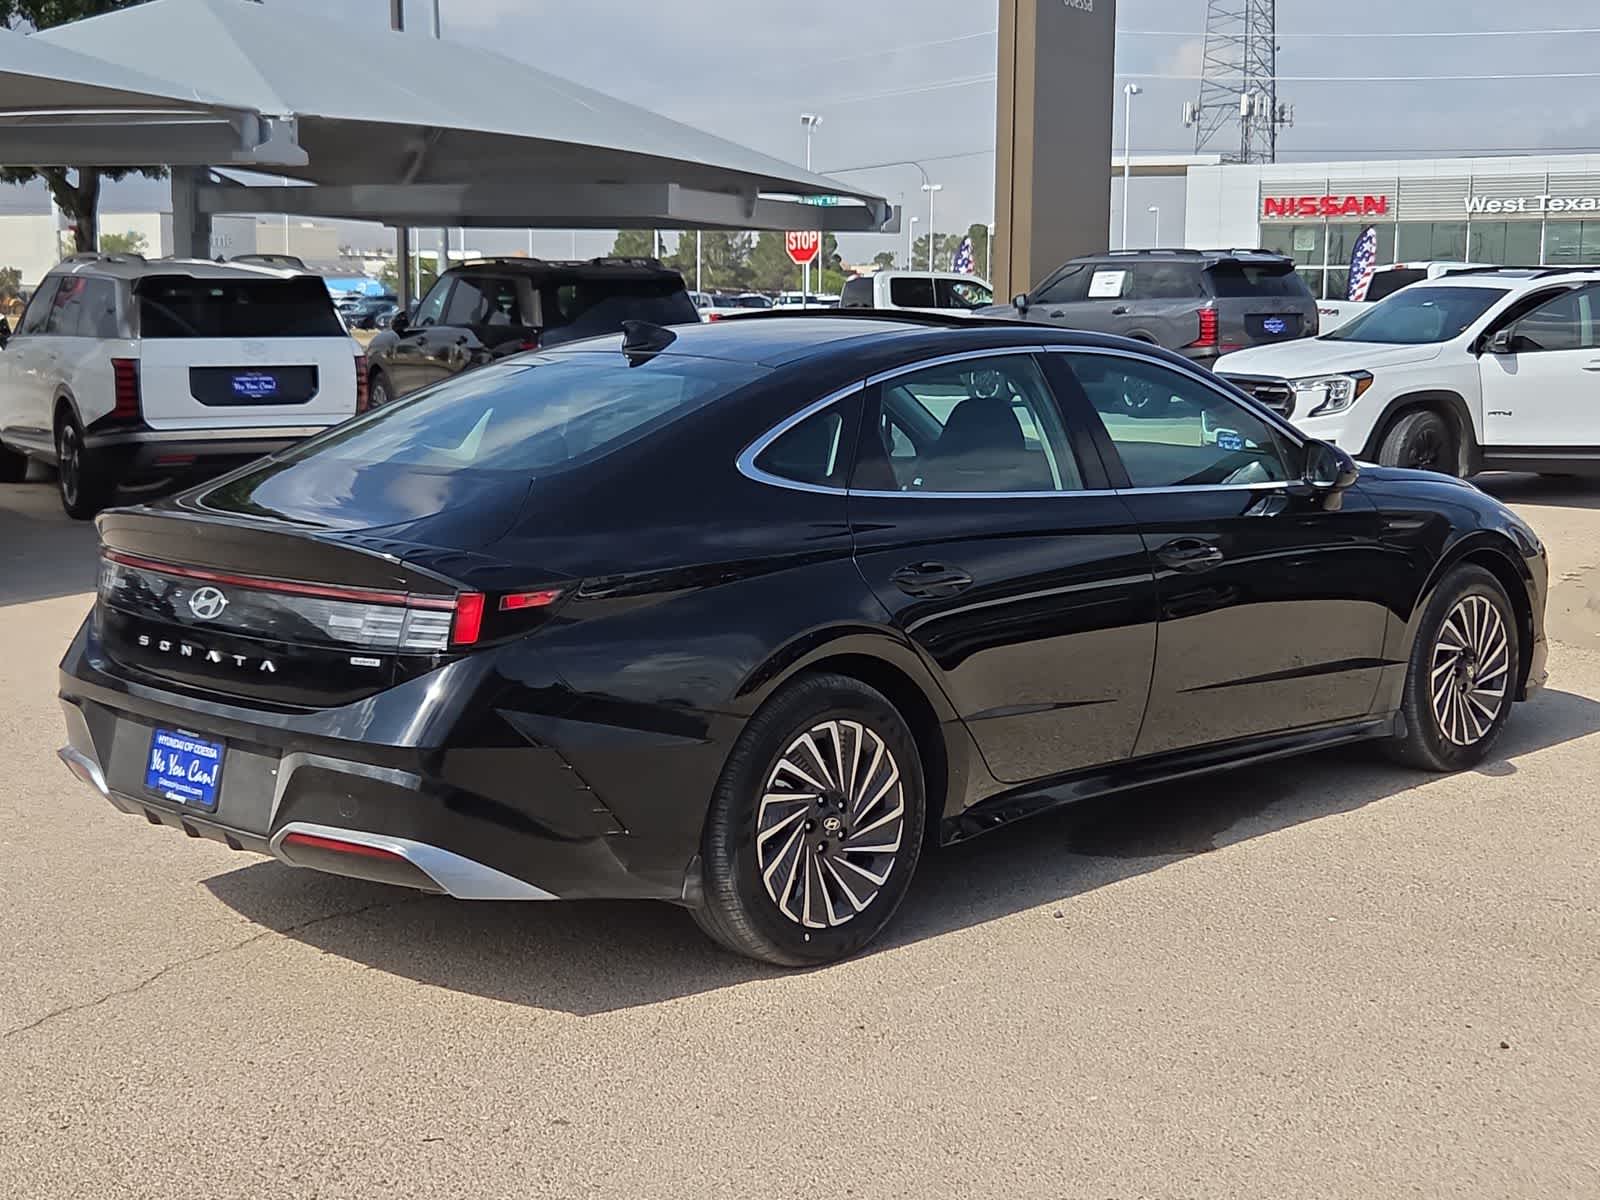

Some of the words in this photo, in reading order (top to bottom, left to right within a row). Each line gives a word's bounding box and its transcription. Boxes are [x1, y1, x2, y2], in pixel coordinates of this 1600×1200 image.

[1264, 196, 1386, 216] NISSAN
[1464, 196, 1527, 214] West
[789, 231, 818, 250] STOP
[138, 635, 276, 673] SONATA
[168, 753, 186, 777] You
